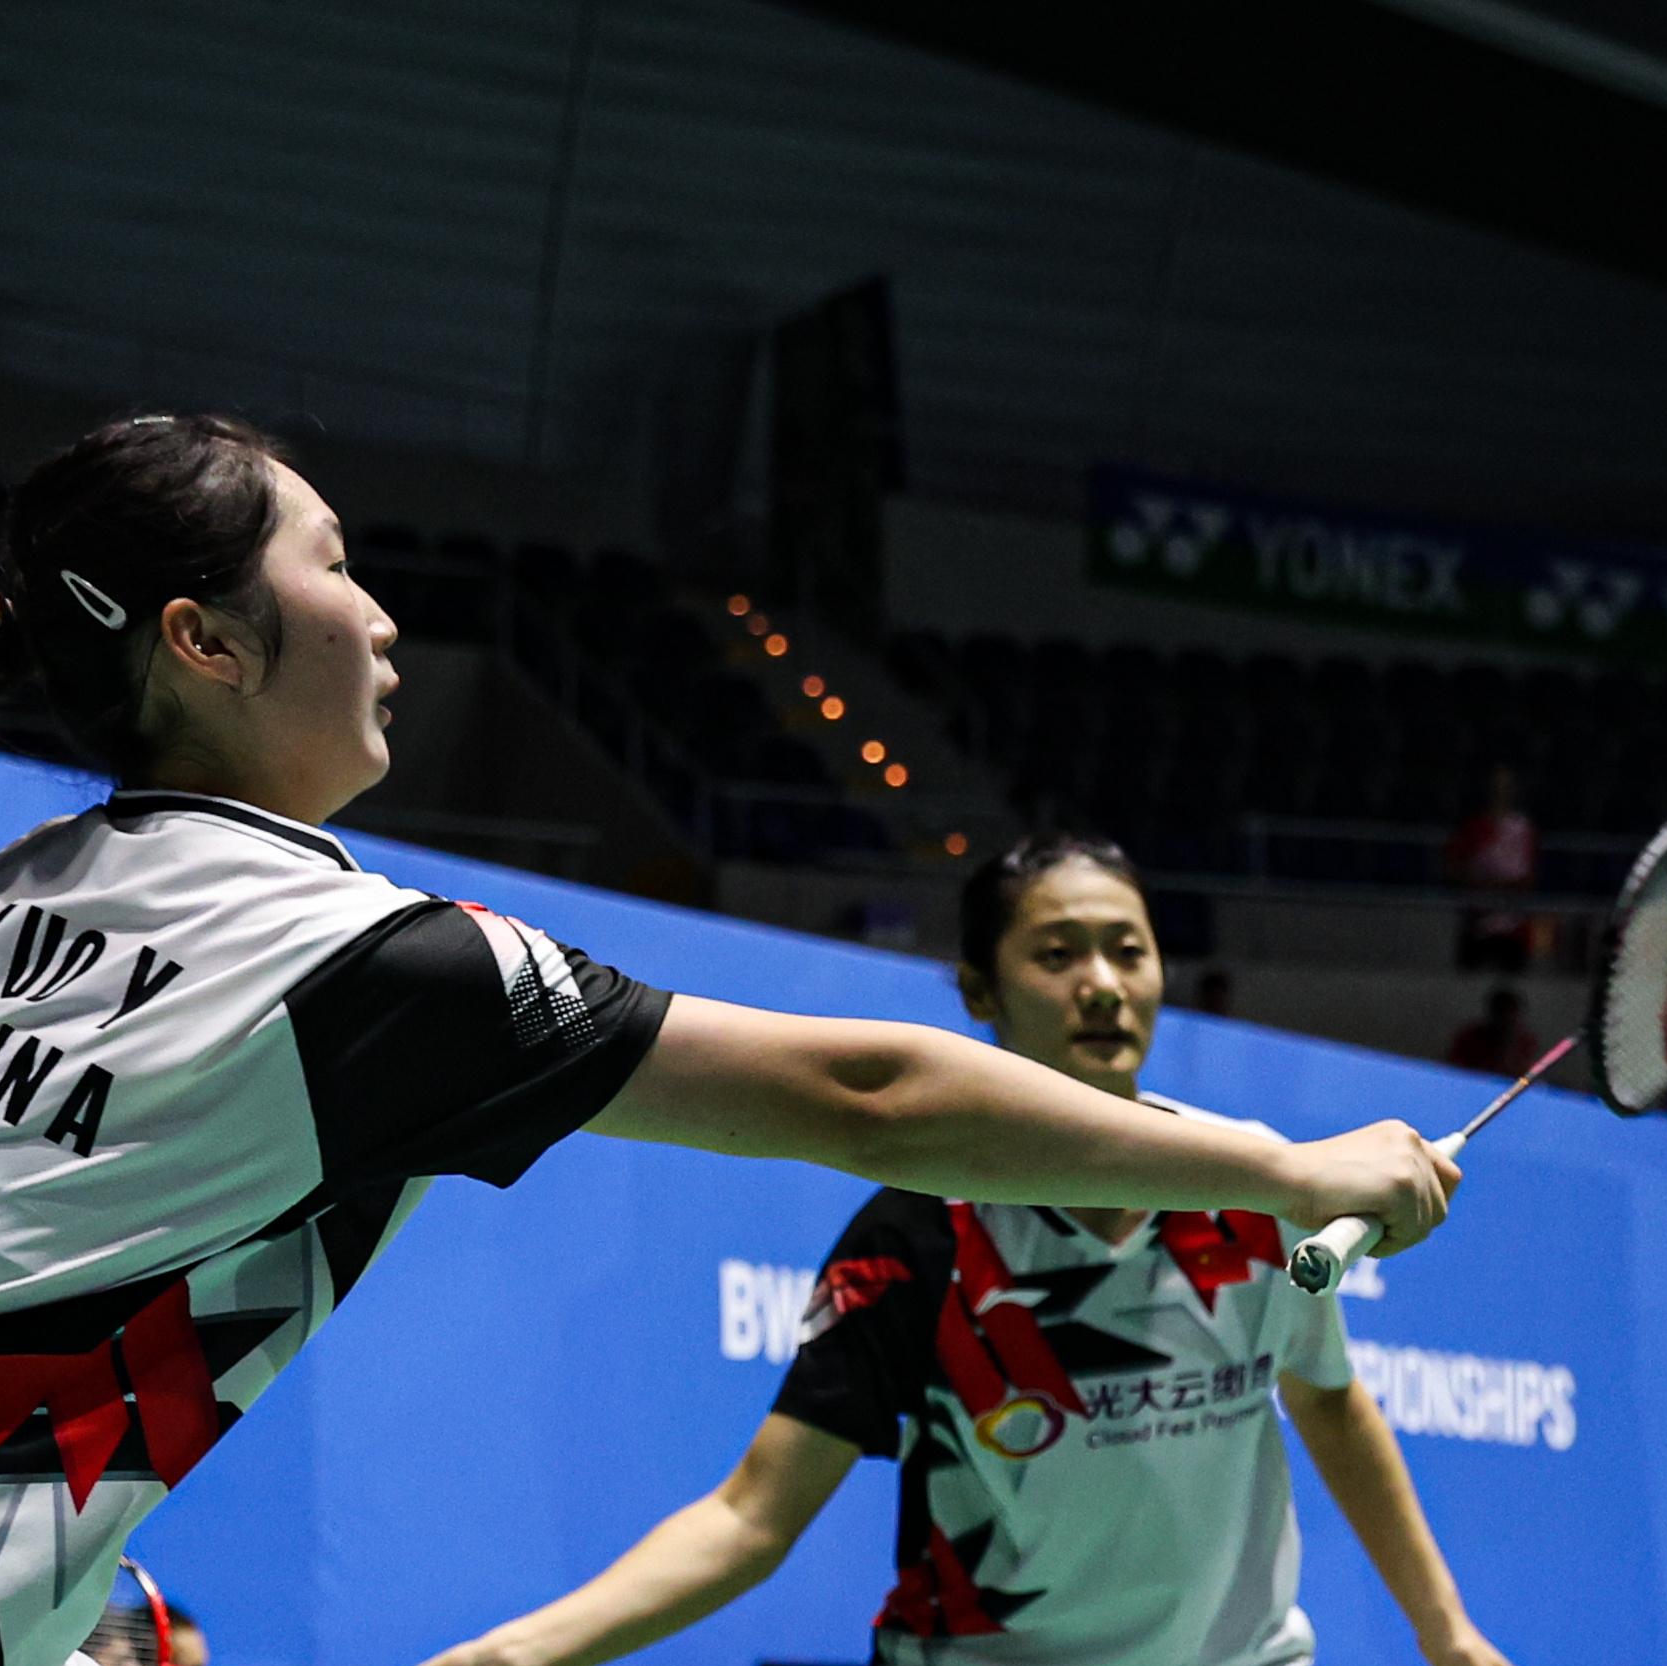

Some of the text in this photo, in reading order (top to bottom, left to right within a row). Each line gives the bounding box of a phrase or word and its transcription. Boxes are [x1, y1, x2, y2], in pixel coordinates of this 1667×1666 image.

[1245, 511, 1465, 615] YONEX
[97, 945, 184, 1029] Y
[717, 1258, 816, 1367] BW
